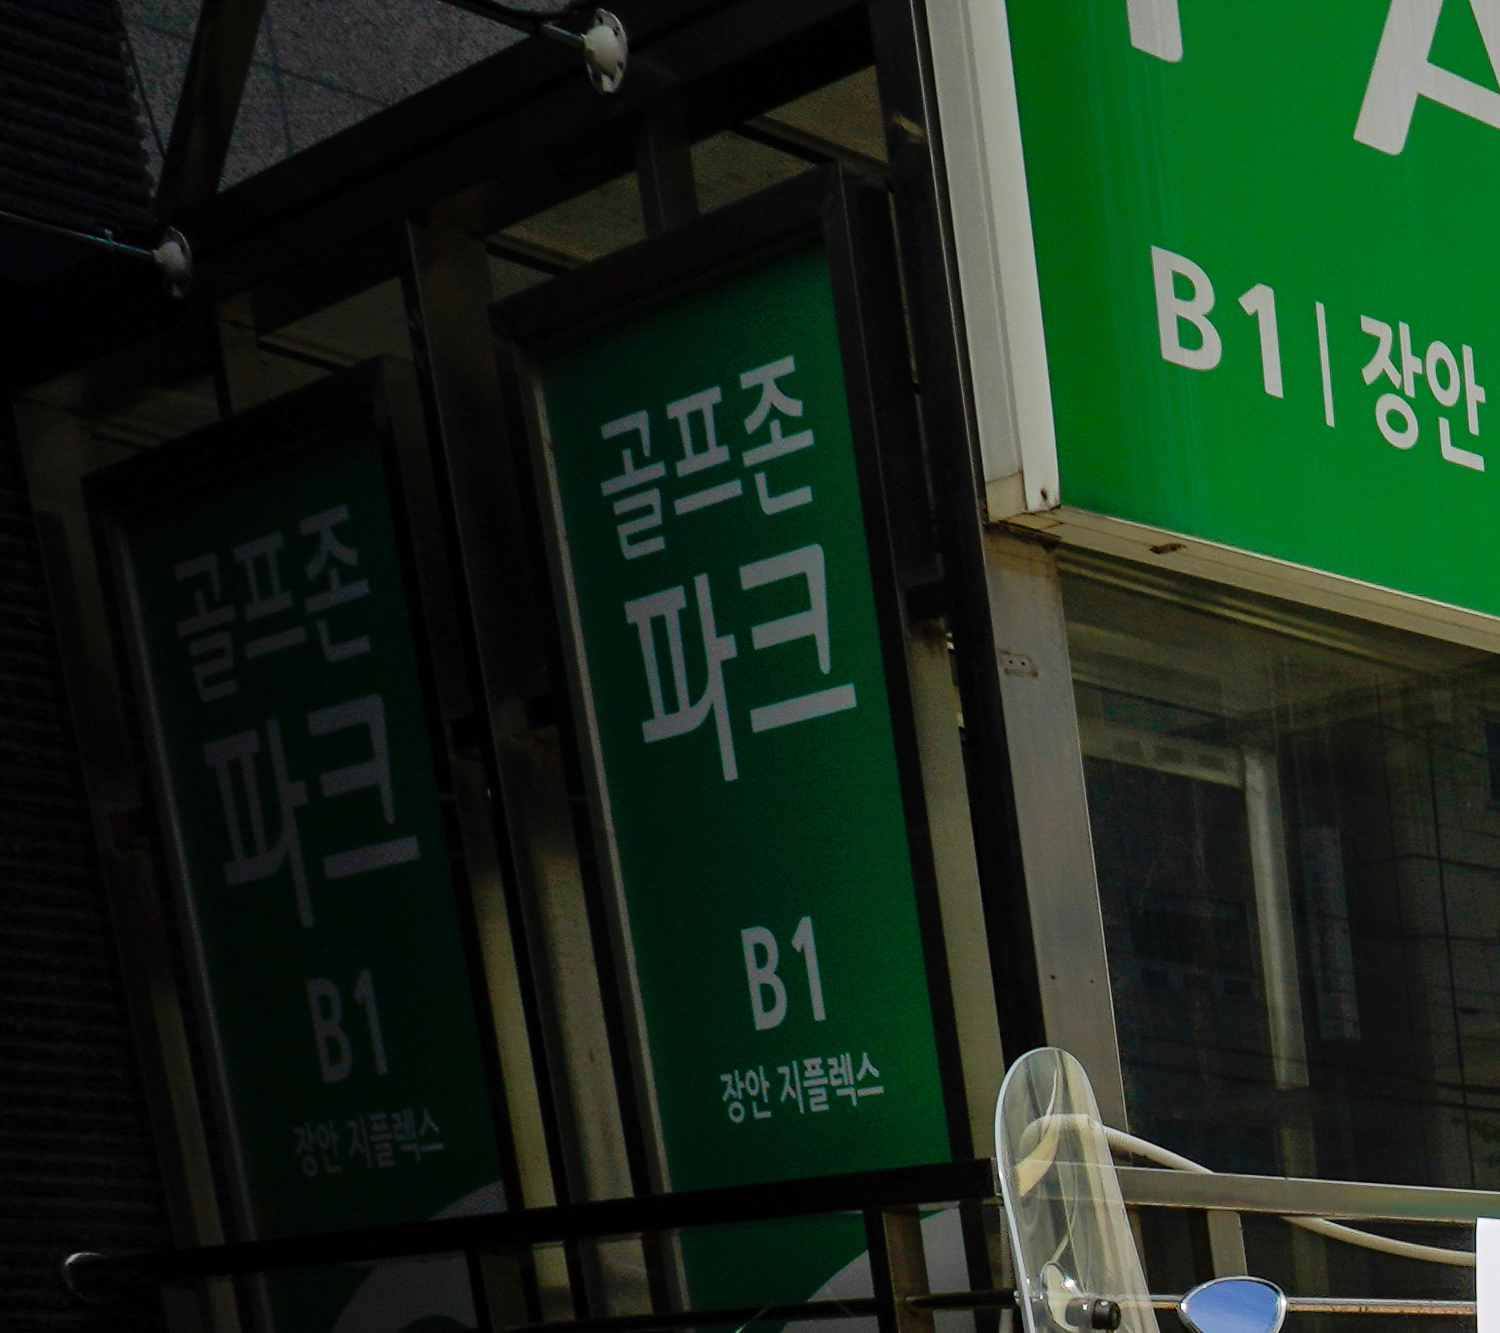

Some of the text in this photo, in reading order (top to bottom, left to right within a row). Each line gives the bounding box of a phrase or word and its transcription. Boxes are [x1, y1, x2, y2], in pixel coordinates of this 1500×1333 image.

[1151, 246, 1283, 398] B1
[1361, 315, 1485, 472] 장안
[601, 355, 814, 561] 골프존
[173, 505, 372, 701] 골프존
[623, 544, 857, 782] 파크
[202, 694, 420, 928] 파크
[306, 968, 388, 1084] B1
[741, 916, 826, 1031] B1
[292, 1108, 444, 1179] 장안 지플렉스
[720, 1052, 884, 1124] 장안 지플렉스
